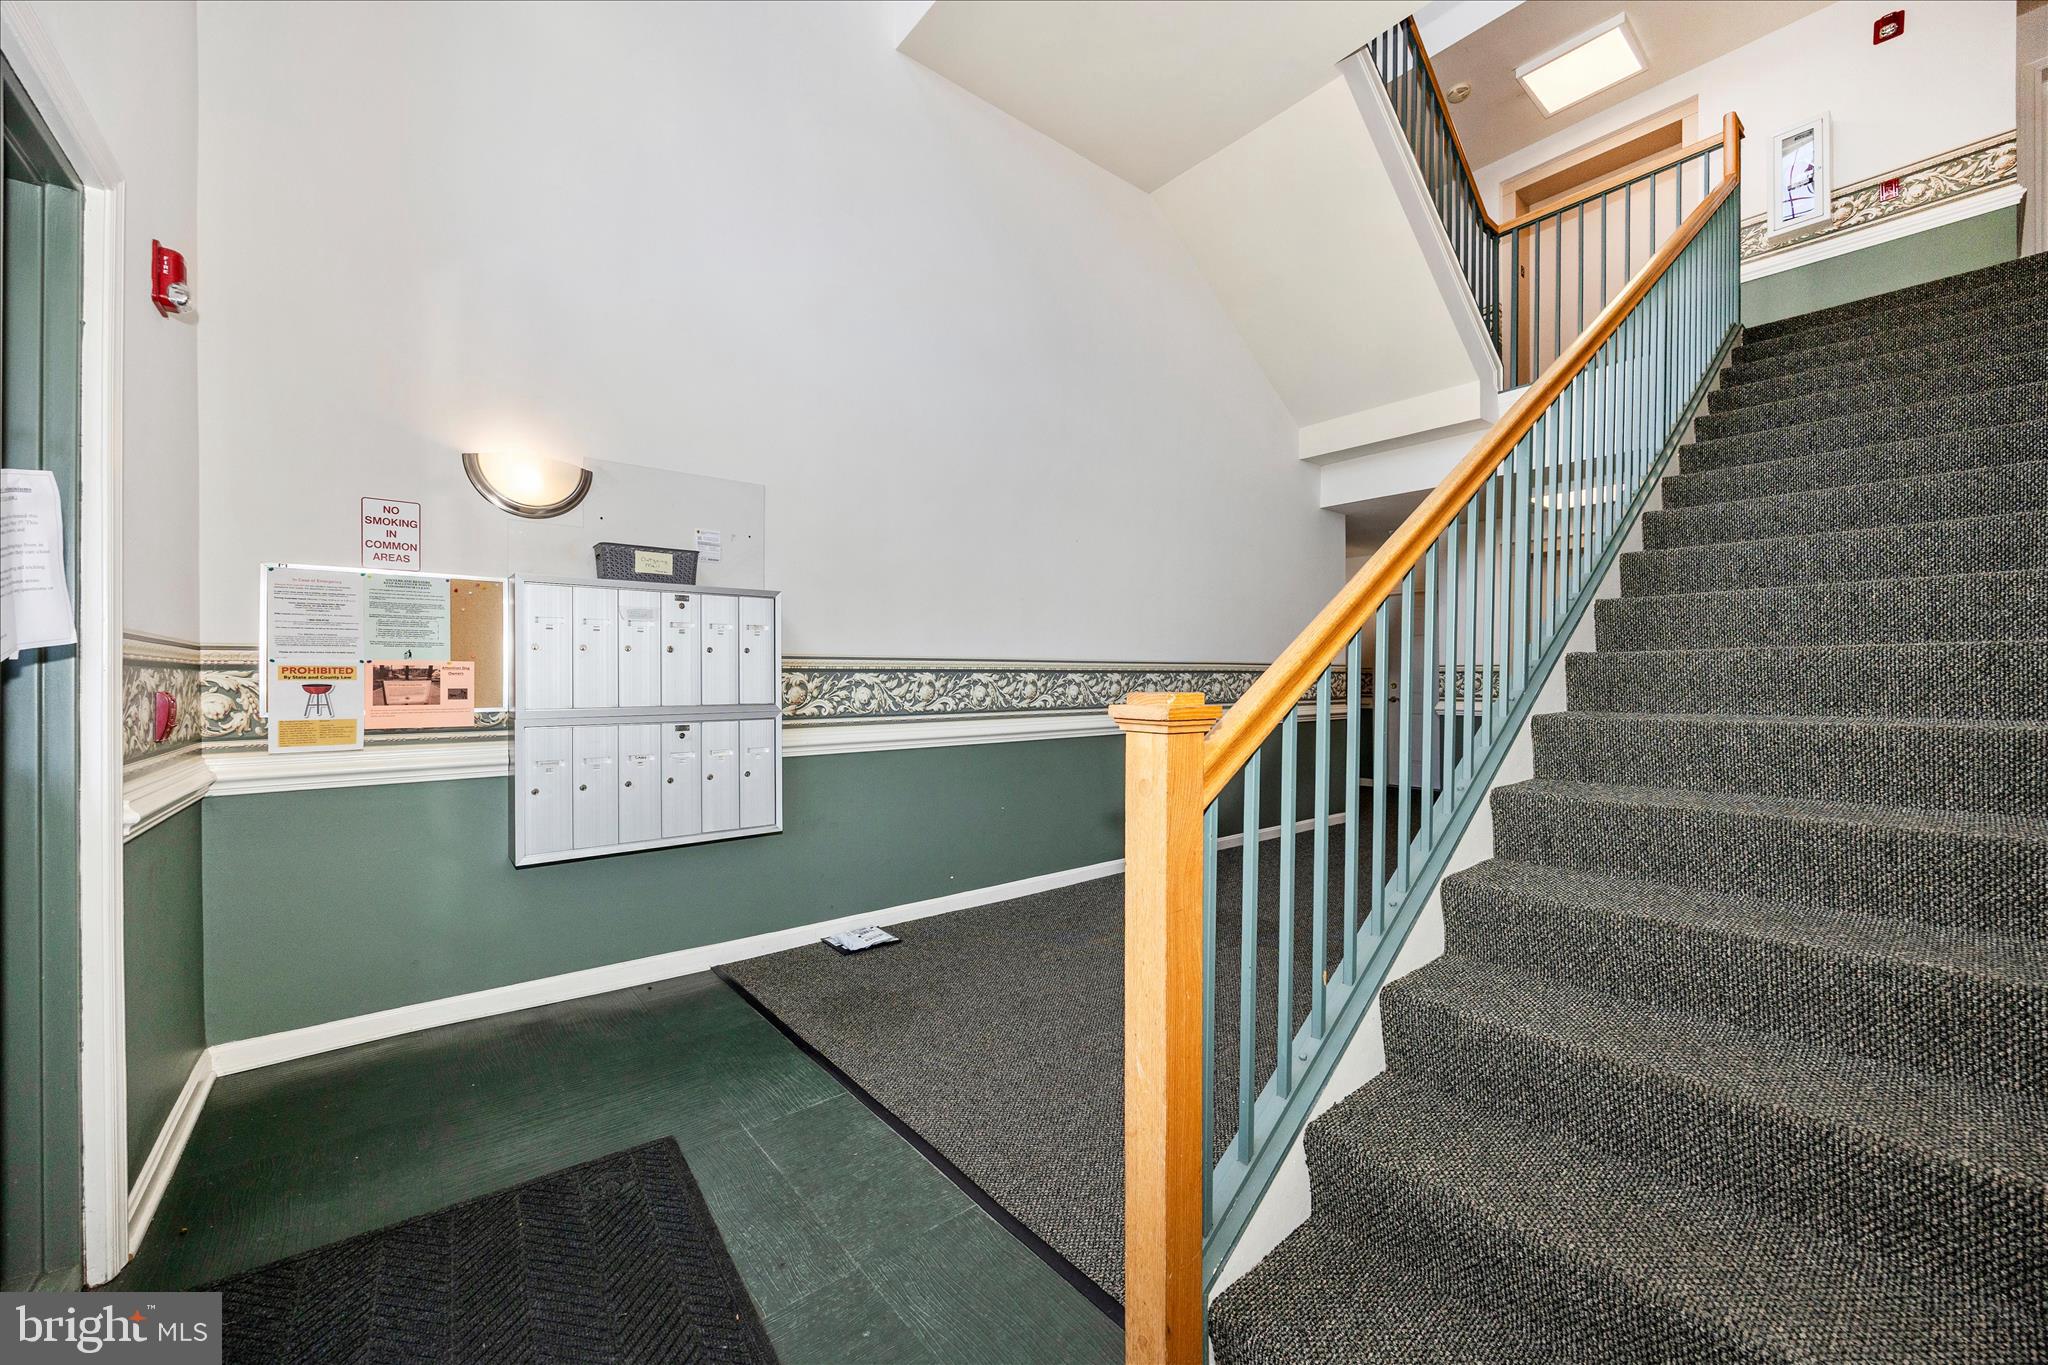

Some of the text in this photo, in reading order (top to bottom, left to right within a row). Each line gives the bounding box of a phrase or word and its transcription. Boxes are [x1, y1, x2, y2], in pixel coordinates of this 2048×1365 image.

[382, 505, 400, 515] NO
[364, 516, 418, 529] SMOKING
[385, 529, 397, 538] IN
[364, 539, 418, 552] COMMON
[372, 553, 411, 563] AREAS
[281, 666, 354, 675] PROHIBITED
